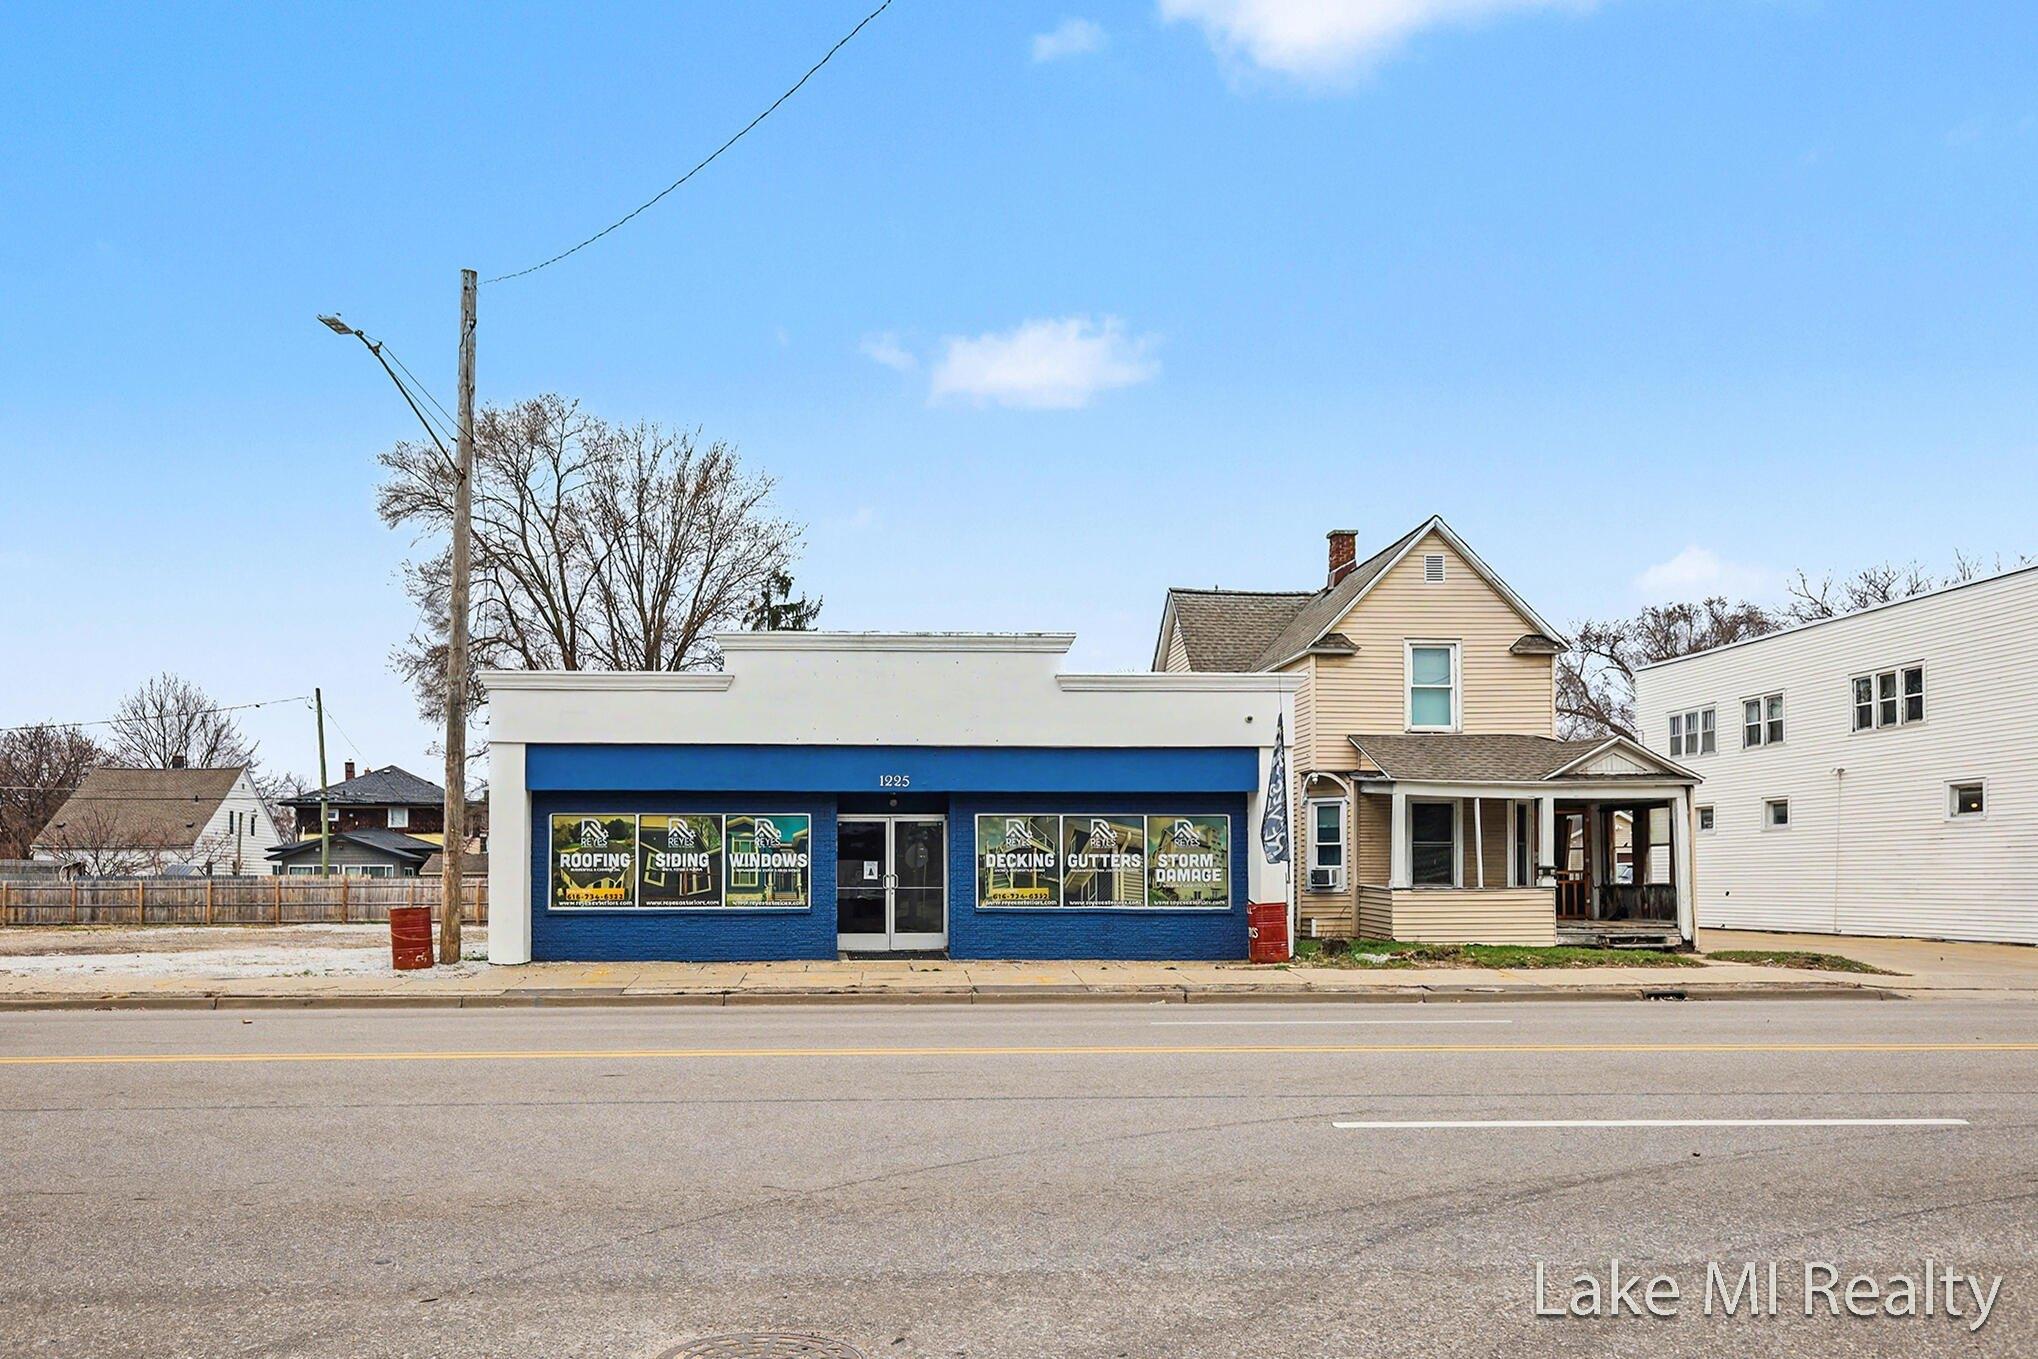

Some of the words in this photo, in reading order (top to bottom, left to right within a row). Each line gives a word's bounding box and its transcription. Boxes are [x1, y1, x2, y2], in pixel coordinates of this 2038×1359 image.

[880, 775, 910, 787] 1225
[581, 837, 608, 846] REYES
[668, 837, 695, 846] REYES
[755, 837, 780, 846] REYES
[1090, 838, 1117, 847] REYES
[560, 853, 631, 868] ROOFING
[655, 853, 710, 868] SIDING
[729, 853, 808, 868] WINDOWS
[986, 853, 1055, 868] DECKING
[1067, 853, 1141, 868] GUTTERS
[1158, 853, 1214, 868] STORM
[1156, 868, 1222, 882] DAMAGE
